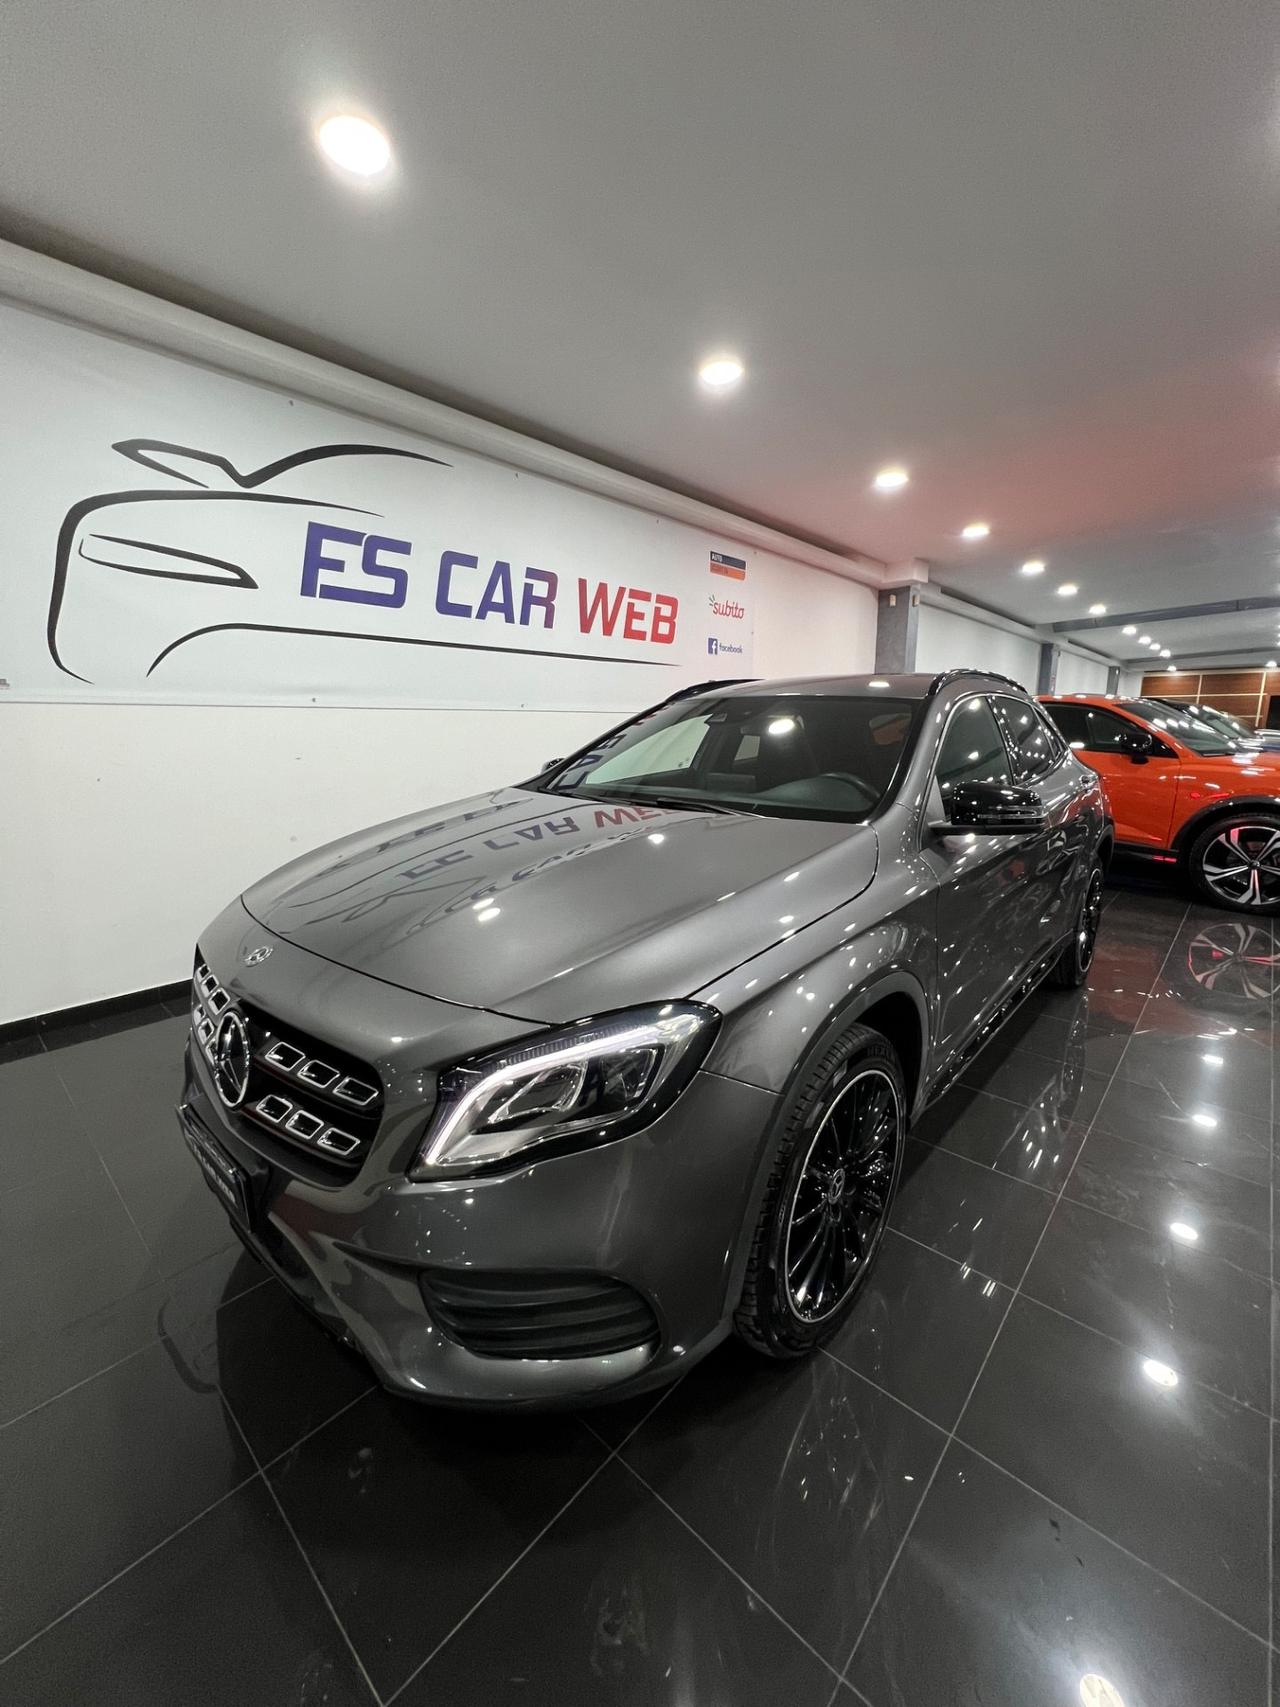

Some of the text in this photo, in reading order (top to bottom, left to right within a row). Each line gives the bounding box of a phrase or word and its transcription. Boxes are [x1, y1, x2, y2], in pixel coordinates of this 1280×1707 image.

[300, 521, 679, 645] ES CAR WEB
[713, 600, 744, 619] subito
[719, 642, 743, 653] facebook
